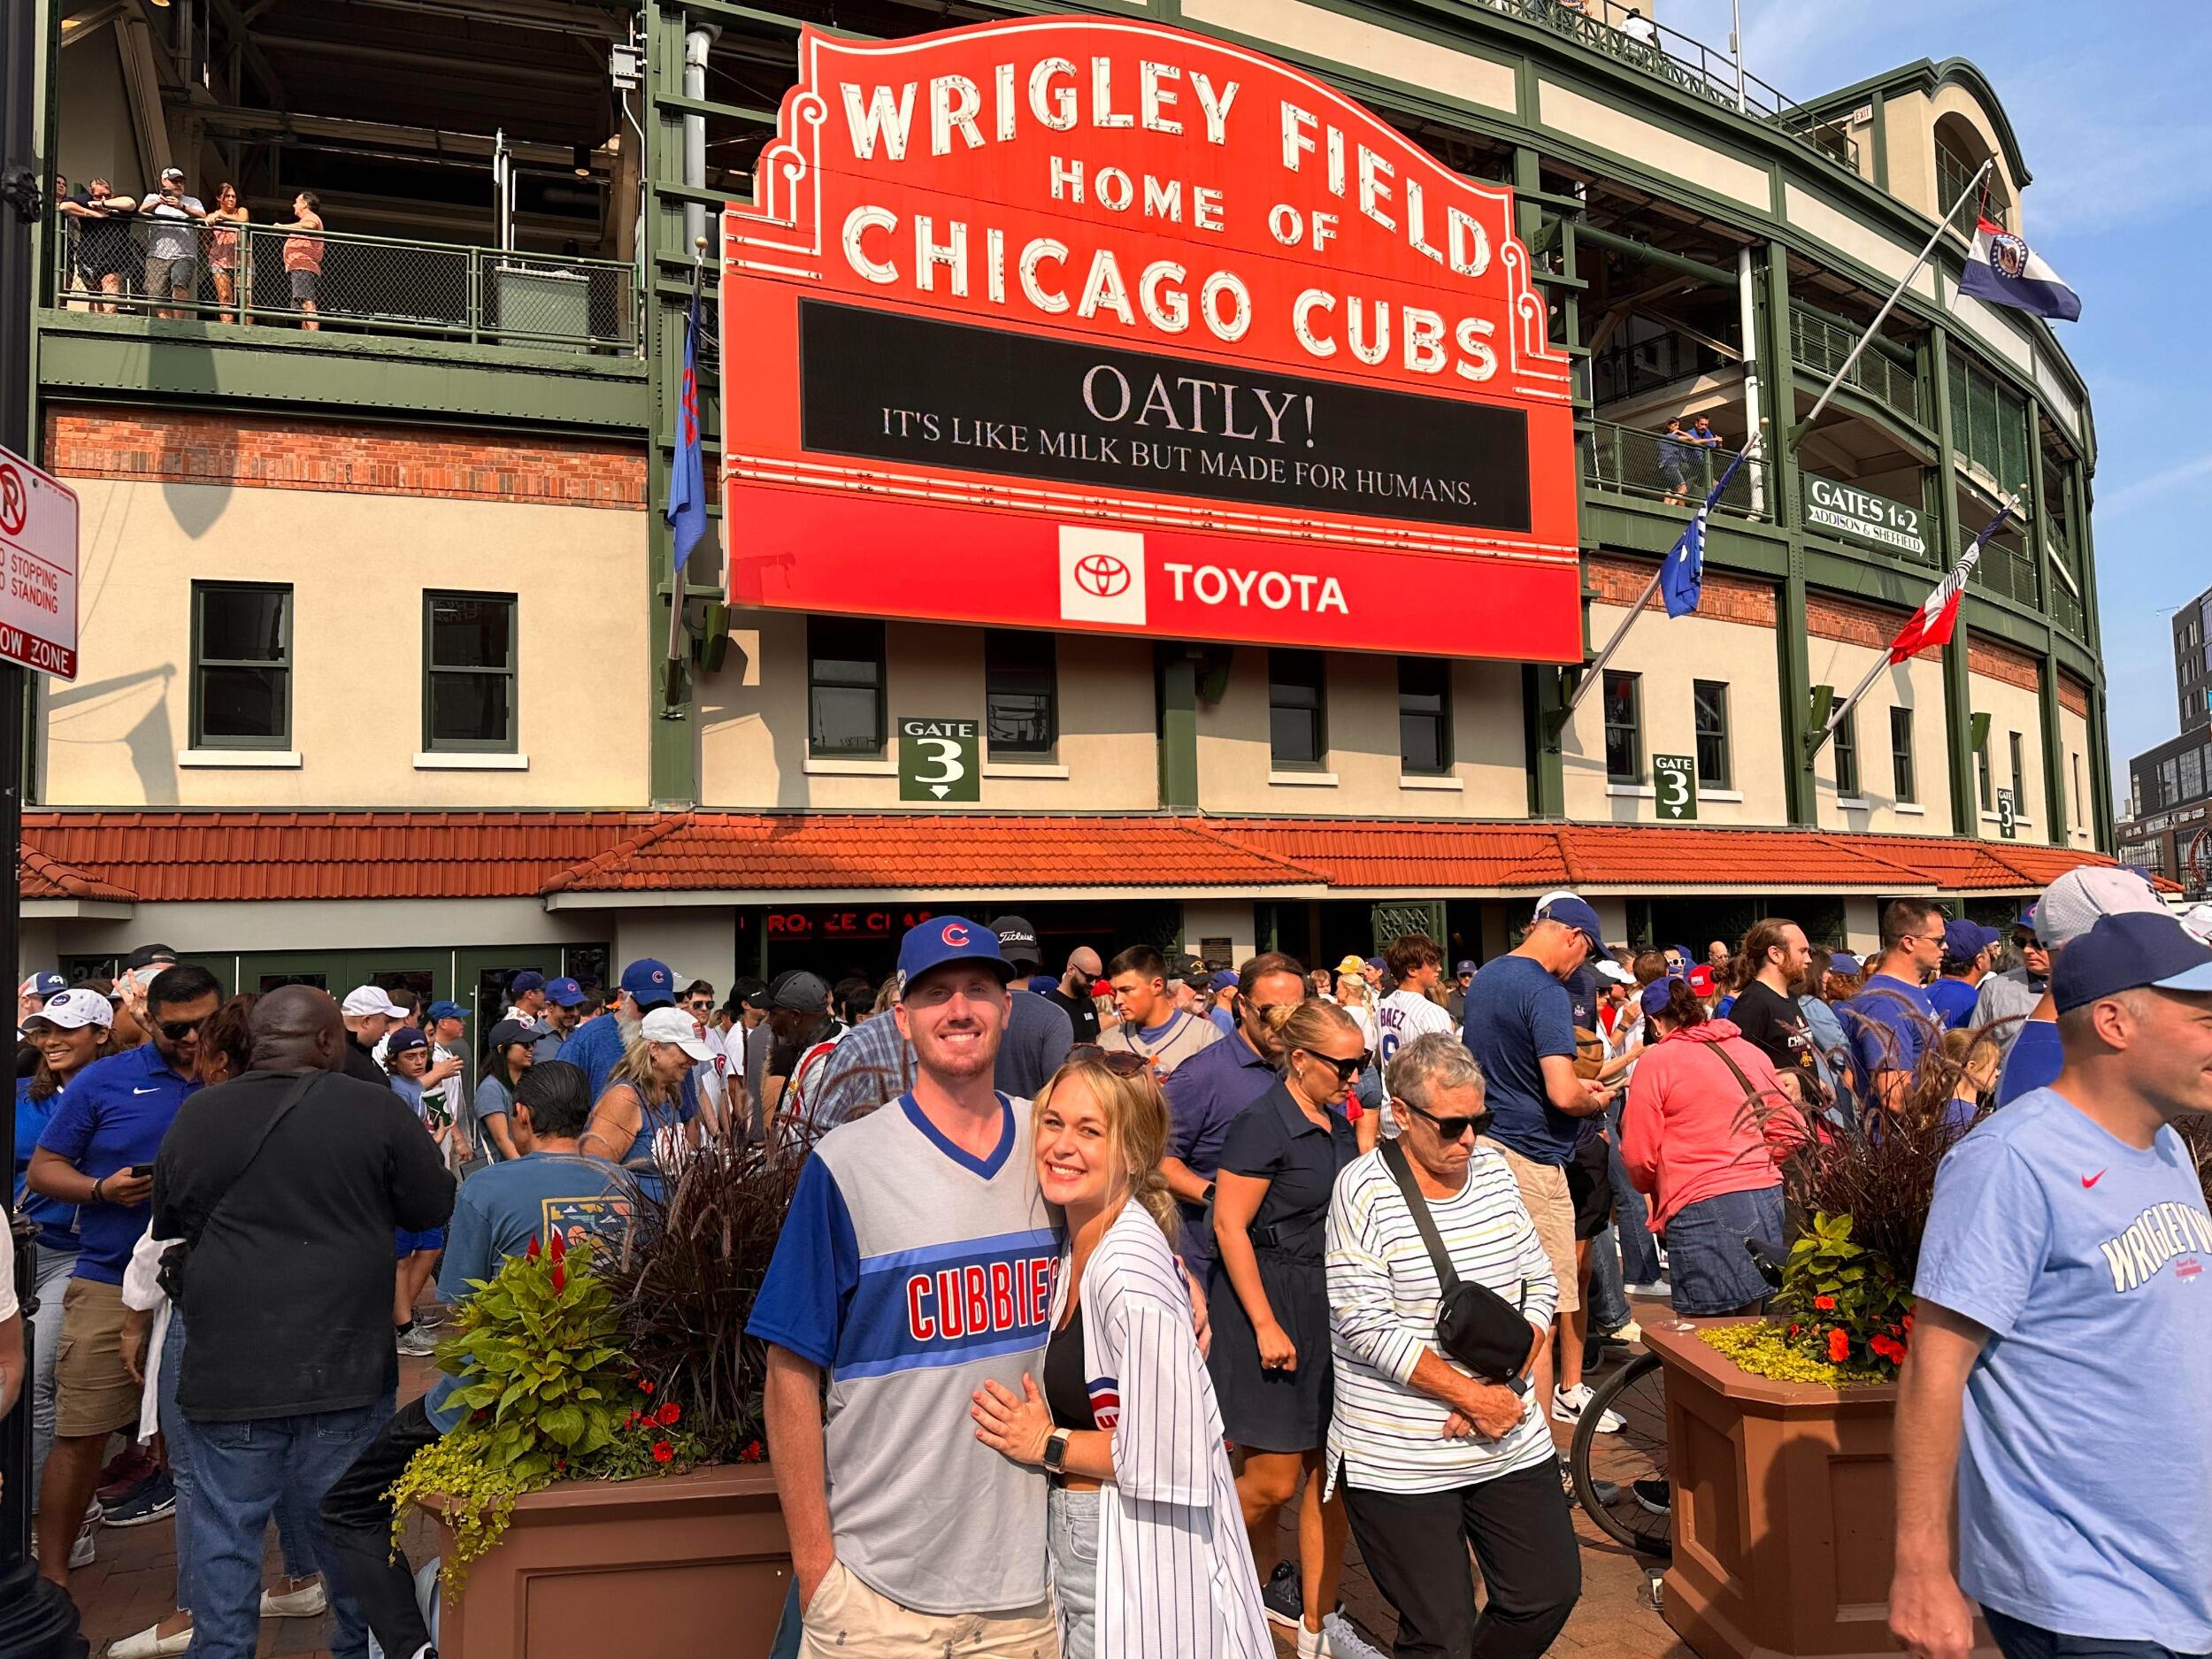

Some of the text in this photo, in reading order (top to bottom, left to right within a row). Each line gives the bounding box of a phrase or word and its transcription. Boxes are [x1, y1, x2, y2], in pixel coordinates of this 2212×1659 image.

[840, 57, 1491, 278] WRIGLEY FIELD
[1050, 156, 1339, 252] HOME OF
[842, 205, 1498, 381] CHICAGO CUBS
[1082, 365, 1314, 449] OATLY!
[881, 407, 1478, 506] IT'S LIKE MILK BUT MADE FOR HUMANS.
[1811, 480, 1884, 522] GATES
[1813, 509, 1920, 551] ADDISON & SHEFFIELD
[11, 553, 58, 592] STOPPING
[1164, 562, 1349, 615] TOYOTA
[11, 577, 58, 614] STANDING
[0, 626, 70, 674] OW ZONE
[904, 721, 973, 738] GATE
[915, 738, 964, 783] 3
[1655, 757, 1693, 771] GATE
[1663, 770, 1689, 805] 3
[1998, 790, 2012, 801] GATE
[2001, 800, 2013, 827] 3
[941, 923, 970, 947] C
[998, 930, 1034, 944] Titleist
[1380, 1008, 1406, 1031] BAEZ
